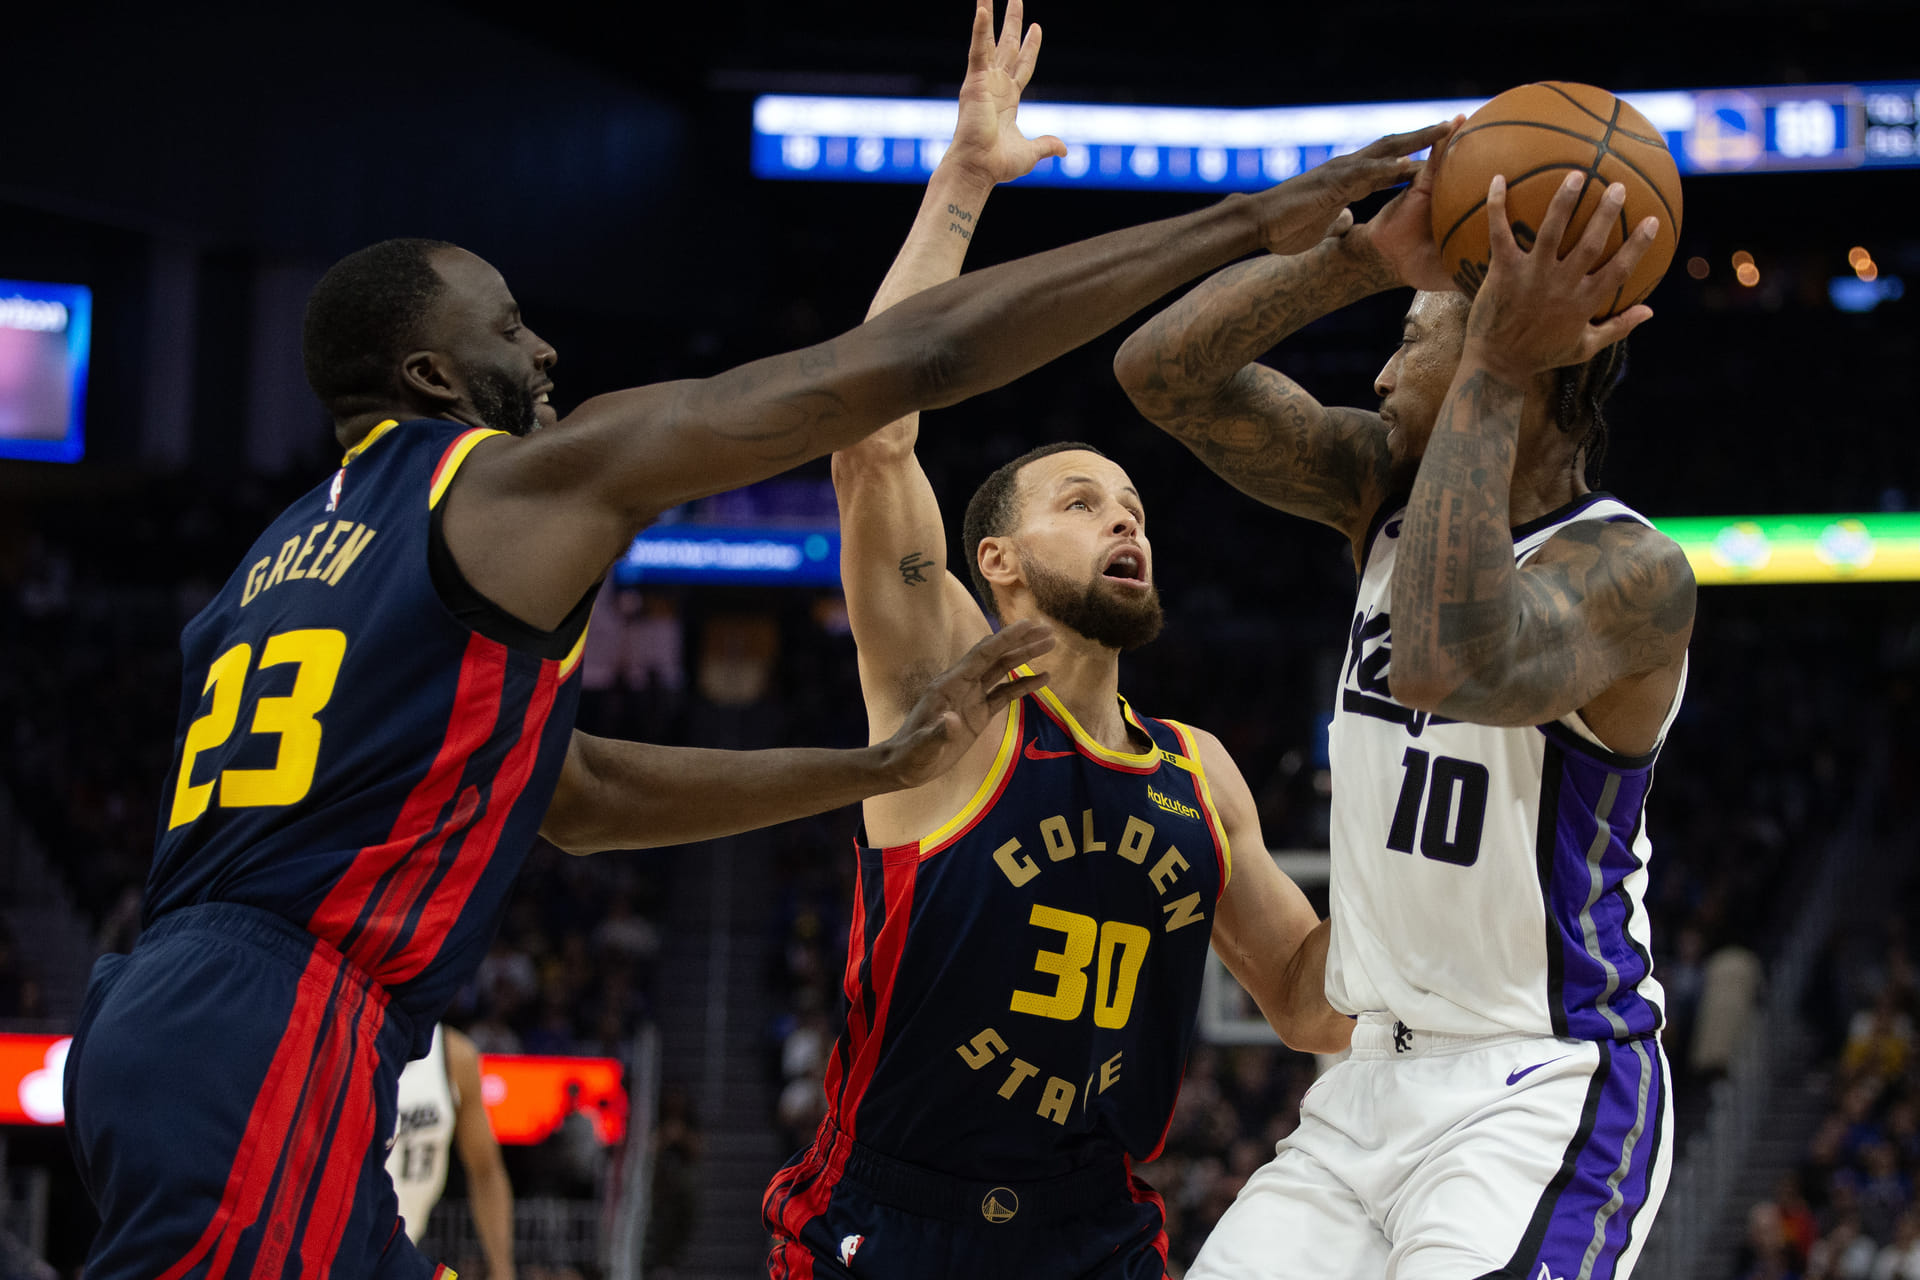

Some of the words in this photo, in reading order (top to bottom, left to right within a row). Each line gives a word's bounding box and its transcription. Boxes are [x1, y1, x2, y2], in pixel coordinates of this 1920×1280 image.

[240, 520, 377, 608] GREEN
[168, 628, 348, 832] 23
[1147, 784, 1200, 820] Rakuten
[1386, 746, 1490, 867] 10
[992, 808, 1206, 933] GOLDEN
[1010, 903, 1151, 1030] 30
[955, 1027, 1123, 1126] STAE
